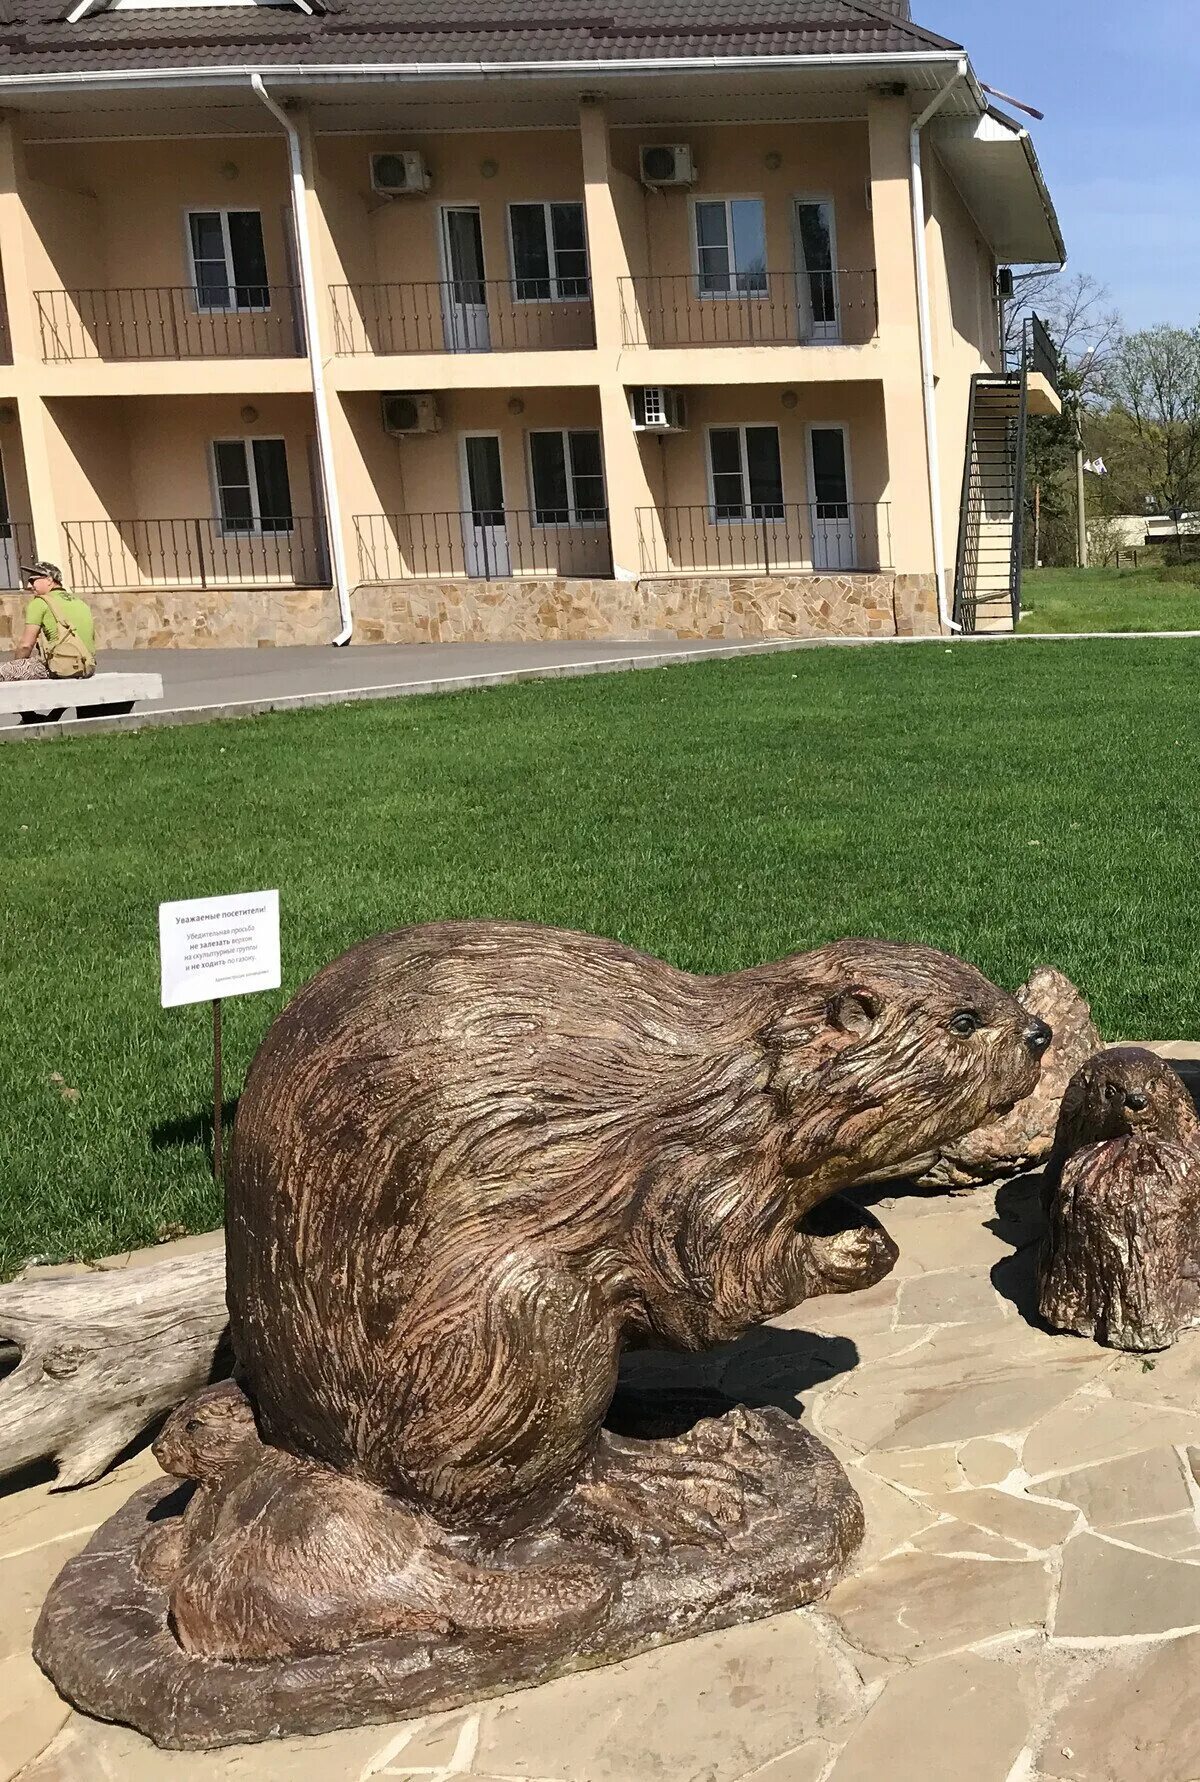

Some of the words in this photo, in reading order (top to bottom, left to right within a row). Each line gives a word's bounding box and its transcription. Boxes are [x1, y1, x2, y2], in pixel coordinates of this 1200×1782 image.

[175, 912, 221, 925] Уважаемые
[222, 907, 266, 918] посетители!
[187, 929, 230, 940] Убедительная
[231, 925, 255, 935] просьба
[200, 939, 230, 949] залезать
[201, 959, 226, 969] ходить
